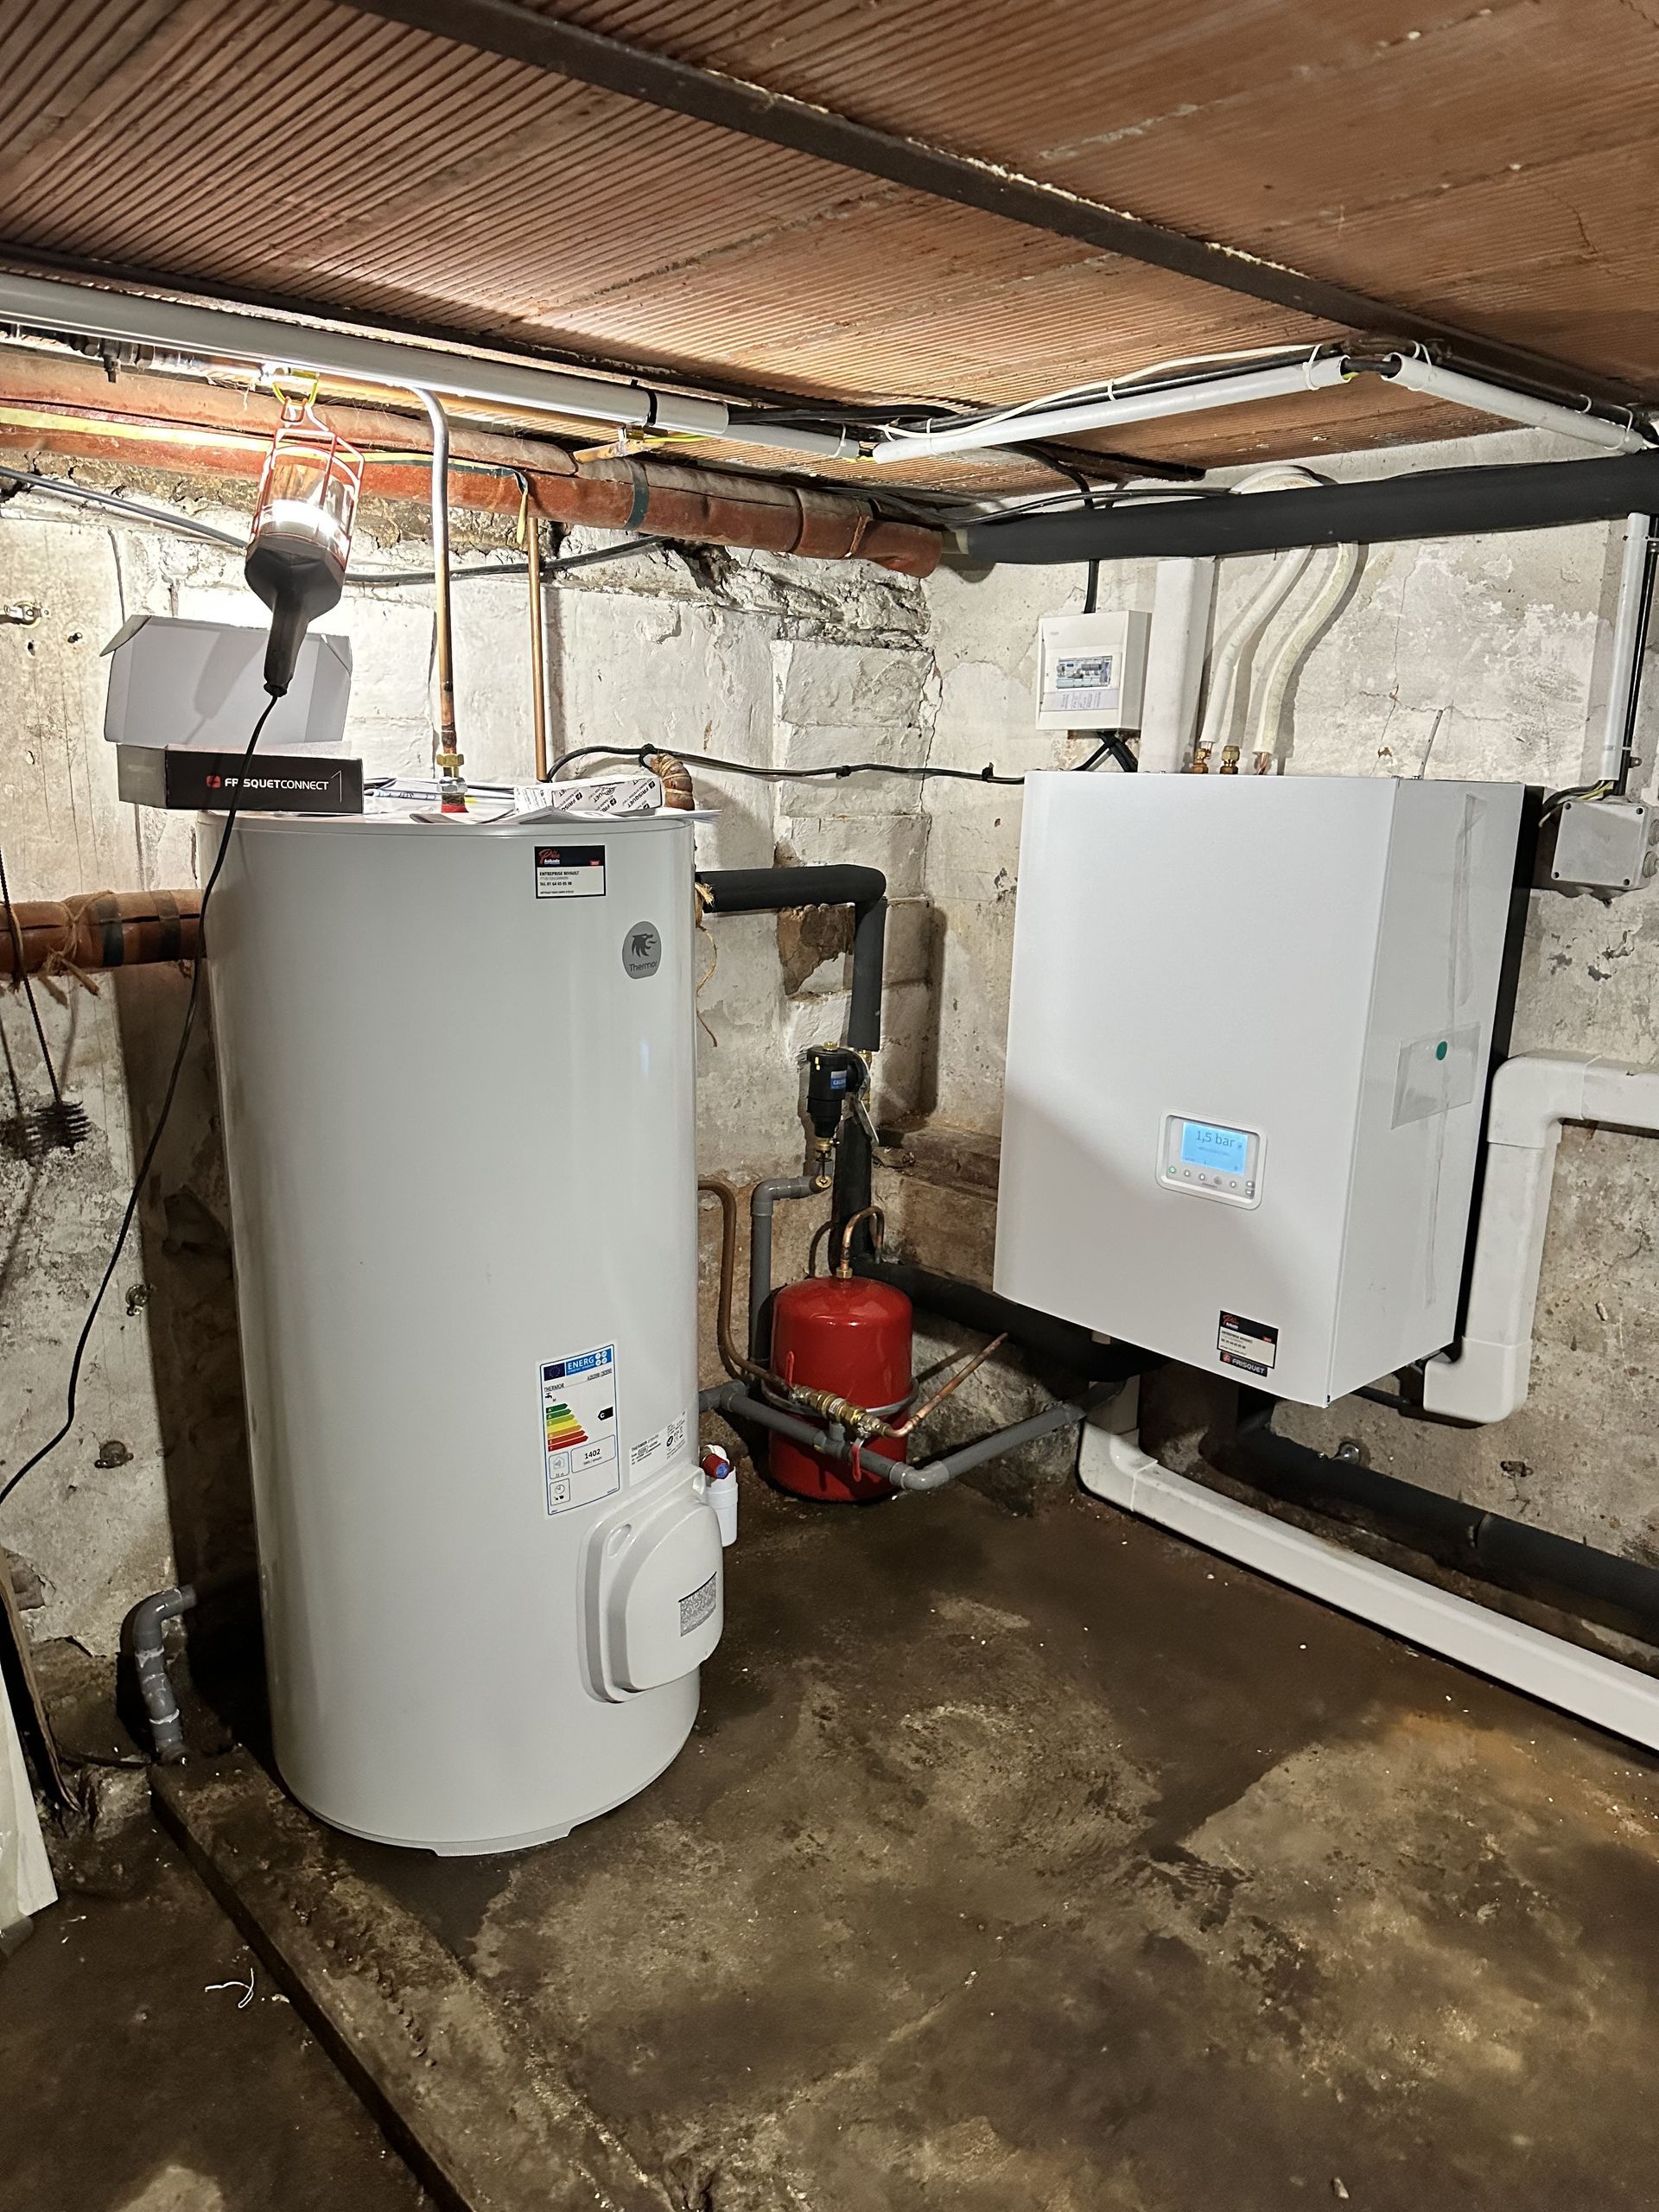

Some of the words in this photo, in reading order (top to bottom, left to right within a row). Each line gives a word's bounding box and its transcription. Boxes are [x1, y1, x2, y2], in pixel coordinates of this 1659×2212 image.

[224, 778, 329, 791] FRSQUETCONNECT
[625, 786, 650, 808] FRISQUET
[628, 960, 658, 972] Thermor
[1196, 1130, 1212, 1143] 1,5
[1215, 1134, 1236, 1147] bar
[568, 1356, 594, 1370] ENERG
[1231, 1358, 1265, 1374] FRISQUET
[543, 1382, 565, 1393] THERMOR
[584, 1448, 601, 1459] 1402
